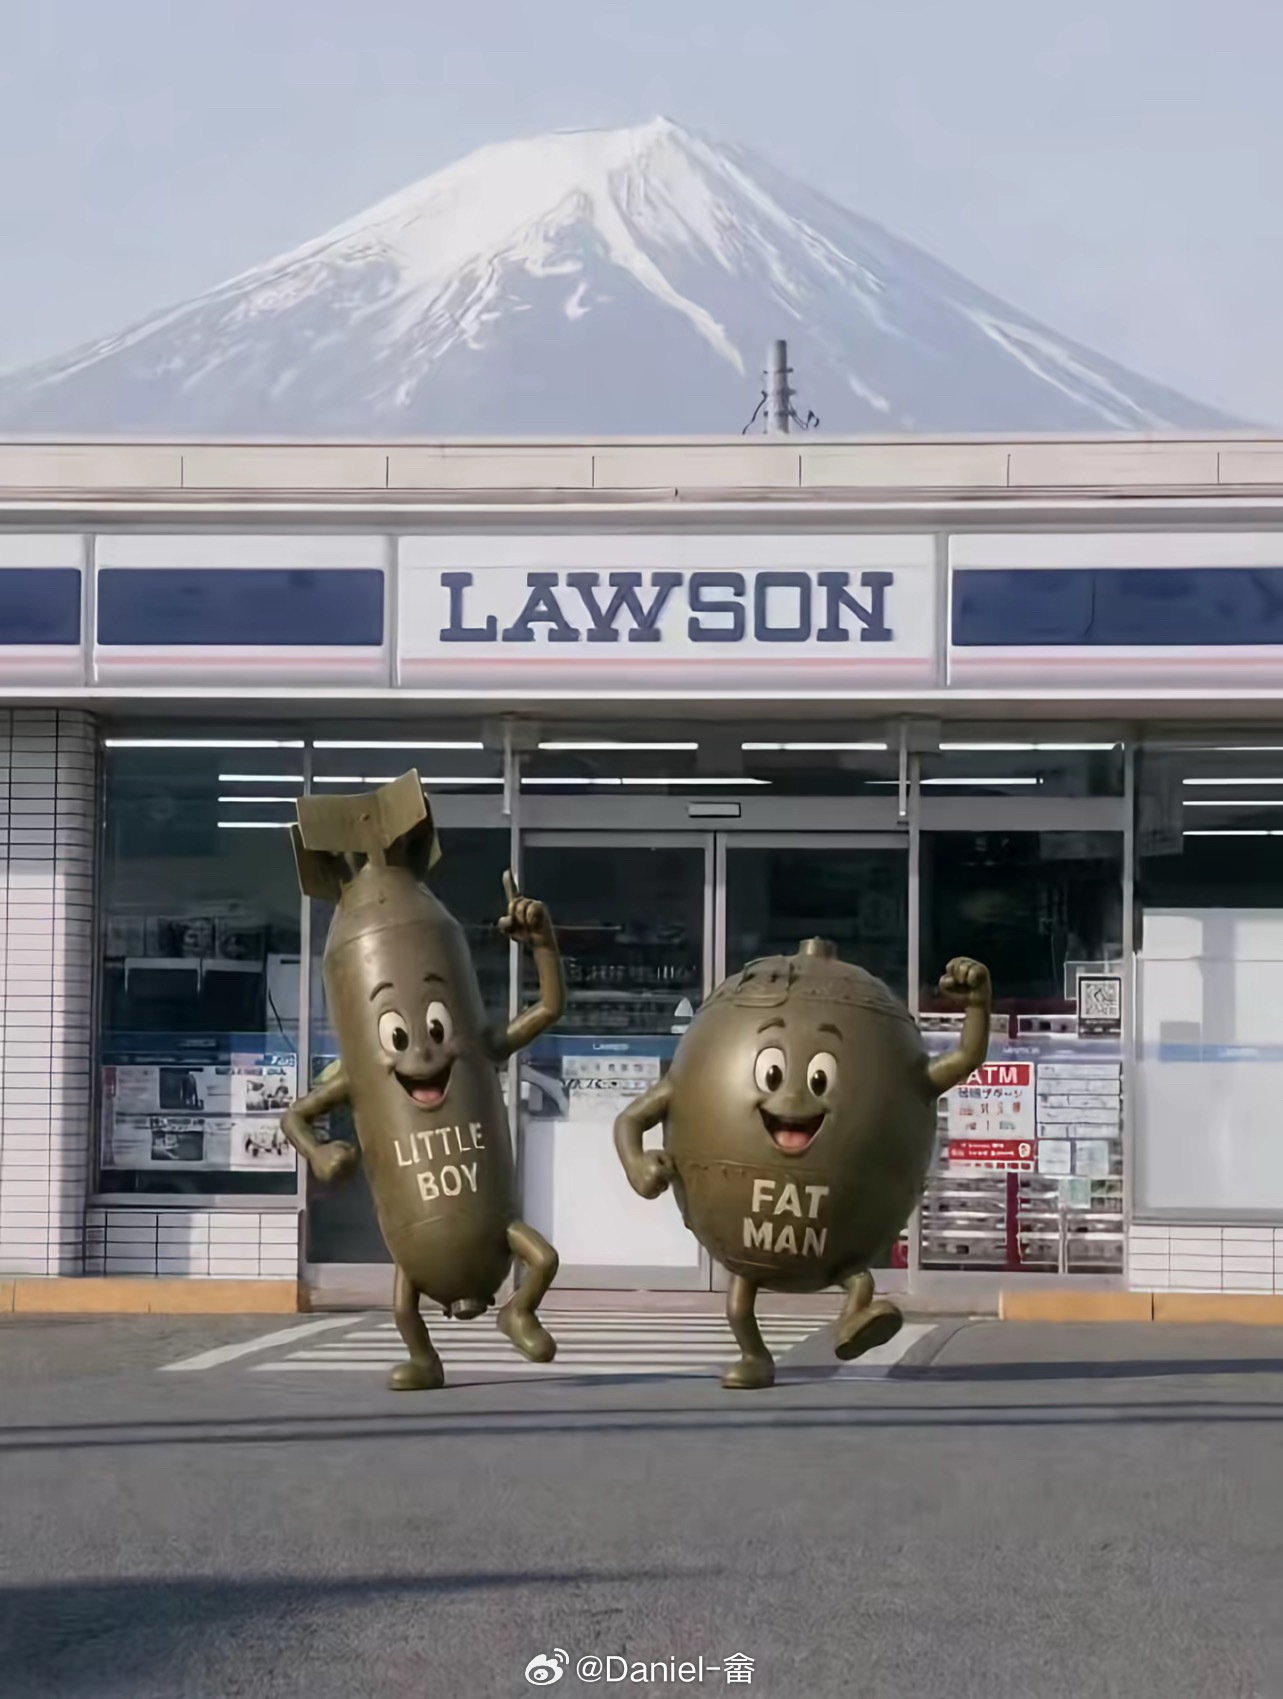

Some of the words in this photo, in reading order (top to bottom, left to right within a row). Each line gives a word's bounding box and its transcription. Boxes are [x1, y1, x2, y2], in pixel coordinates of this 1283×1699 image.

[439, 572, 894, 643] LAWSON
[966, 1066, 1018, 1085] ATM
[394, 1122, 486, 1167] LITTLE
[416, 1162, 477, 1202] BOY
[751, 1179, 830, 1219] FAT
[743, 1216, 828, 1258] MAN
